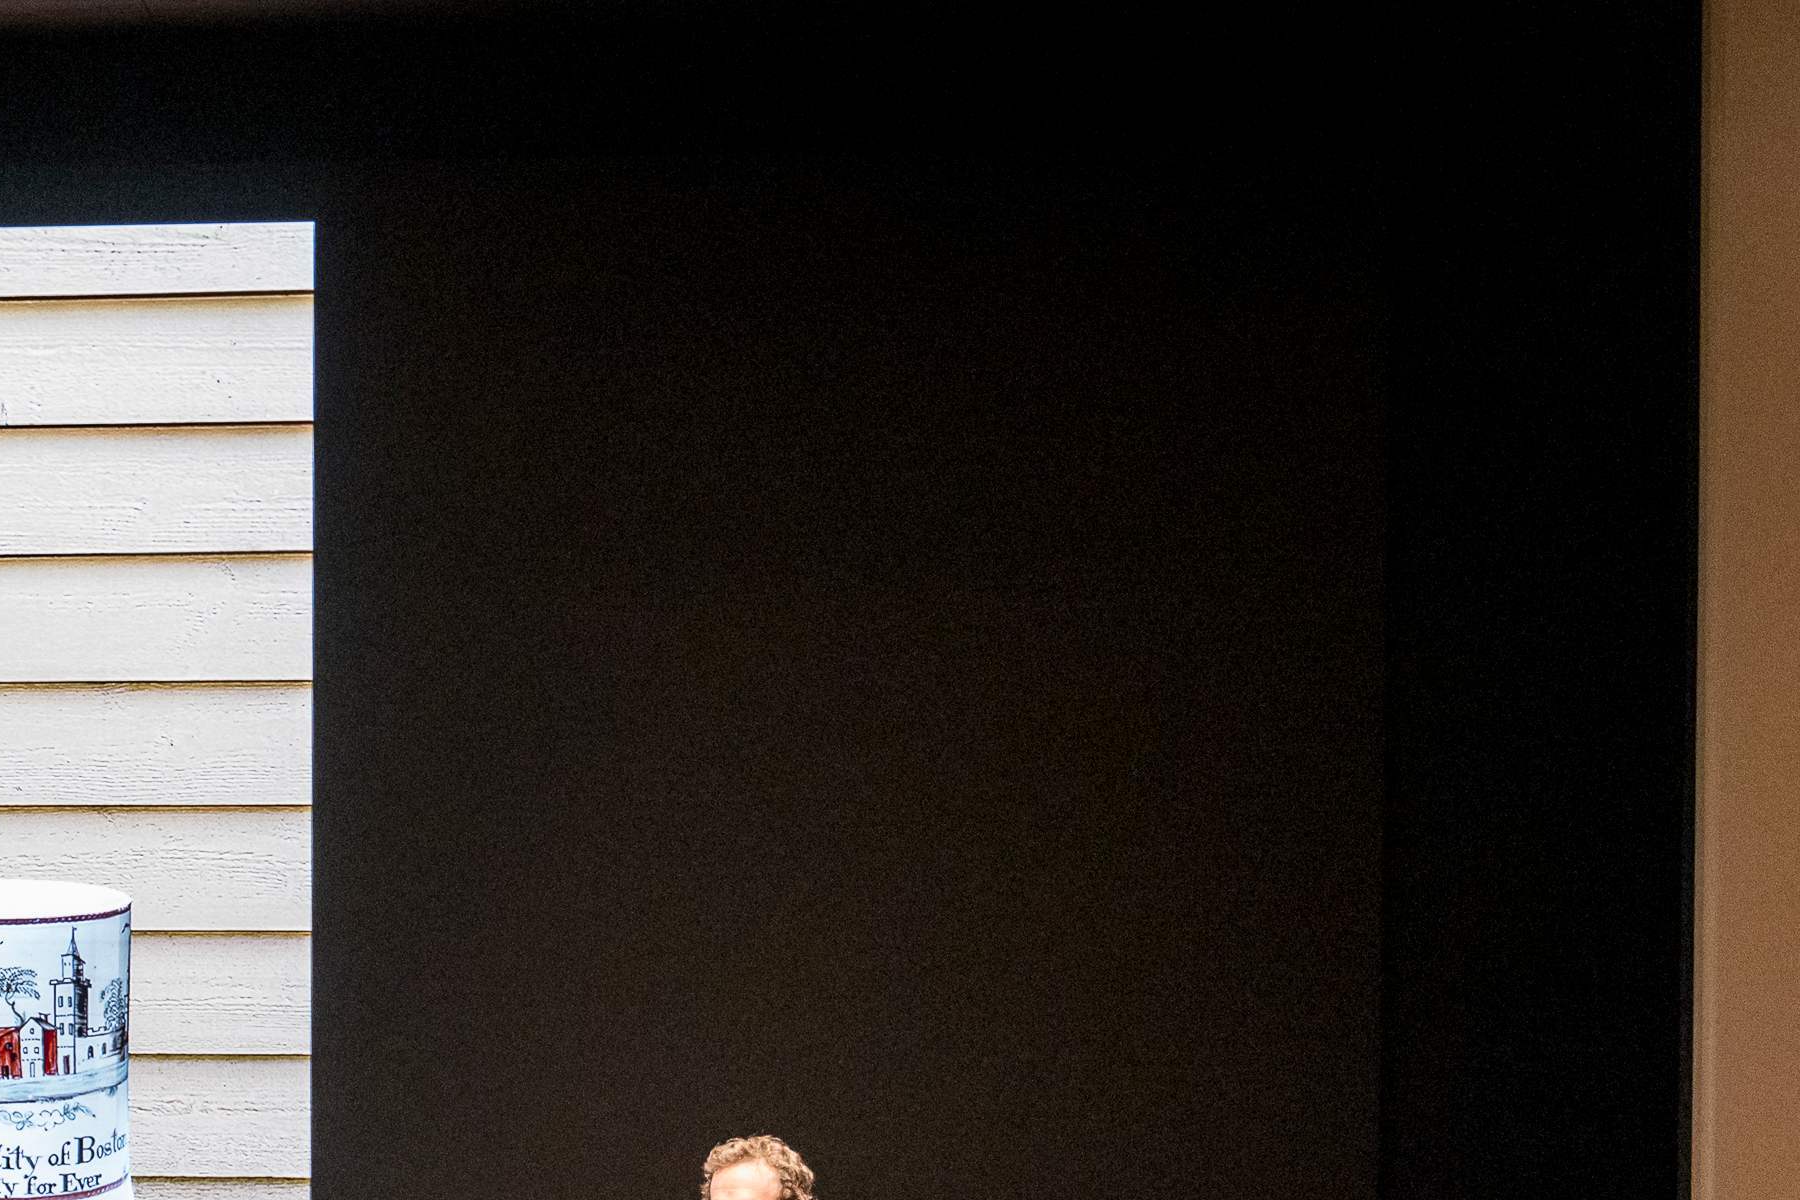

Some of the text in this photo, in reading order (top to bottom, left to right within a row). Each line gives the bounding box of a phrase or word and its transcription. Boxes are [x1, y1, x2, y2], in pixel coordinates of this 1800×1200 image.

[48, 1141, 71, 1166] of
[74, 1128, 127, 1165] Bosto
[25, 1176, 57, 1195] for
[59, 1172, 102, 1193] Ever
